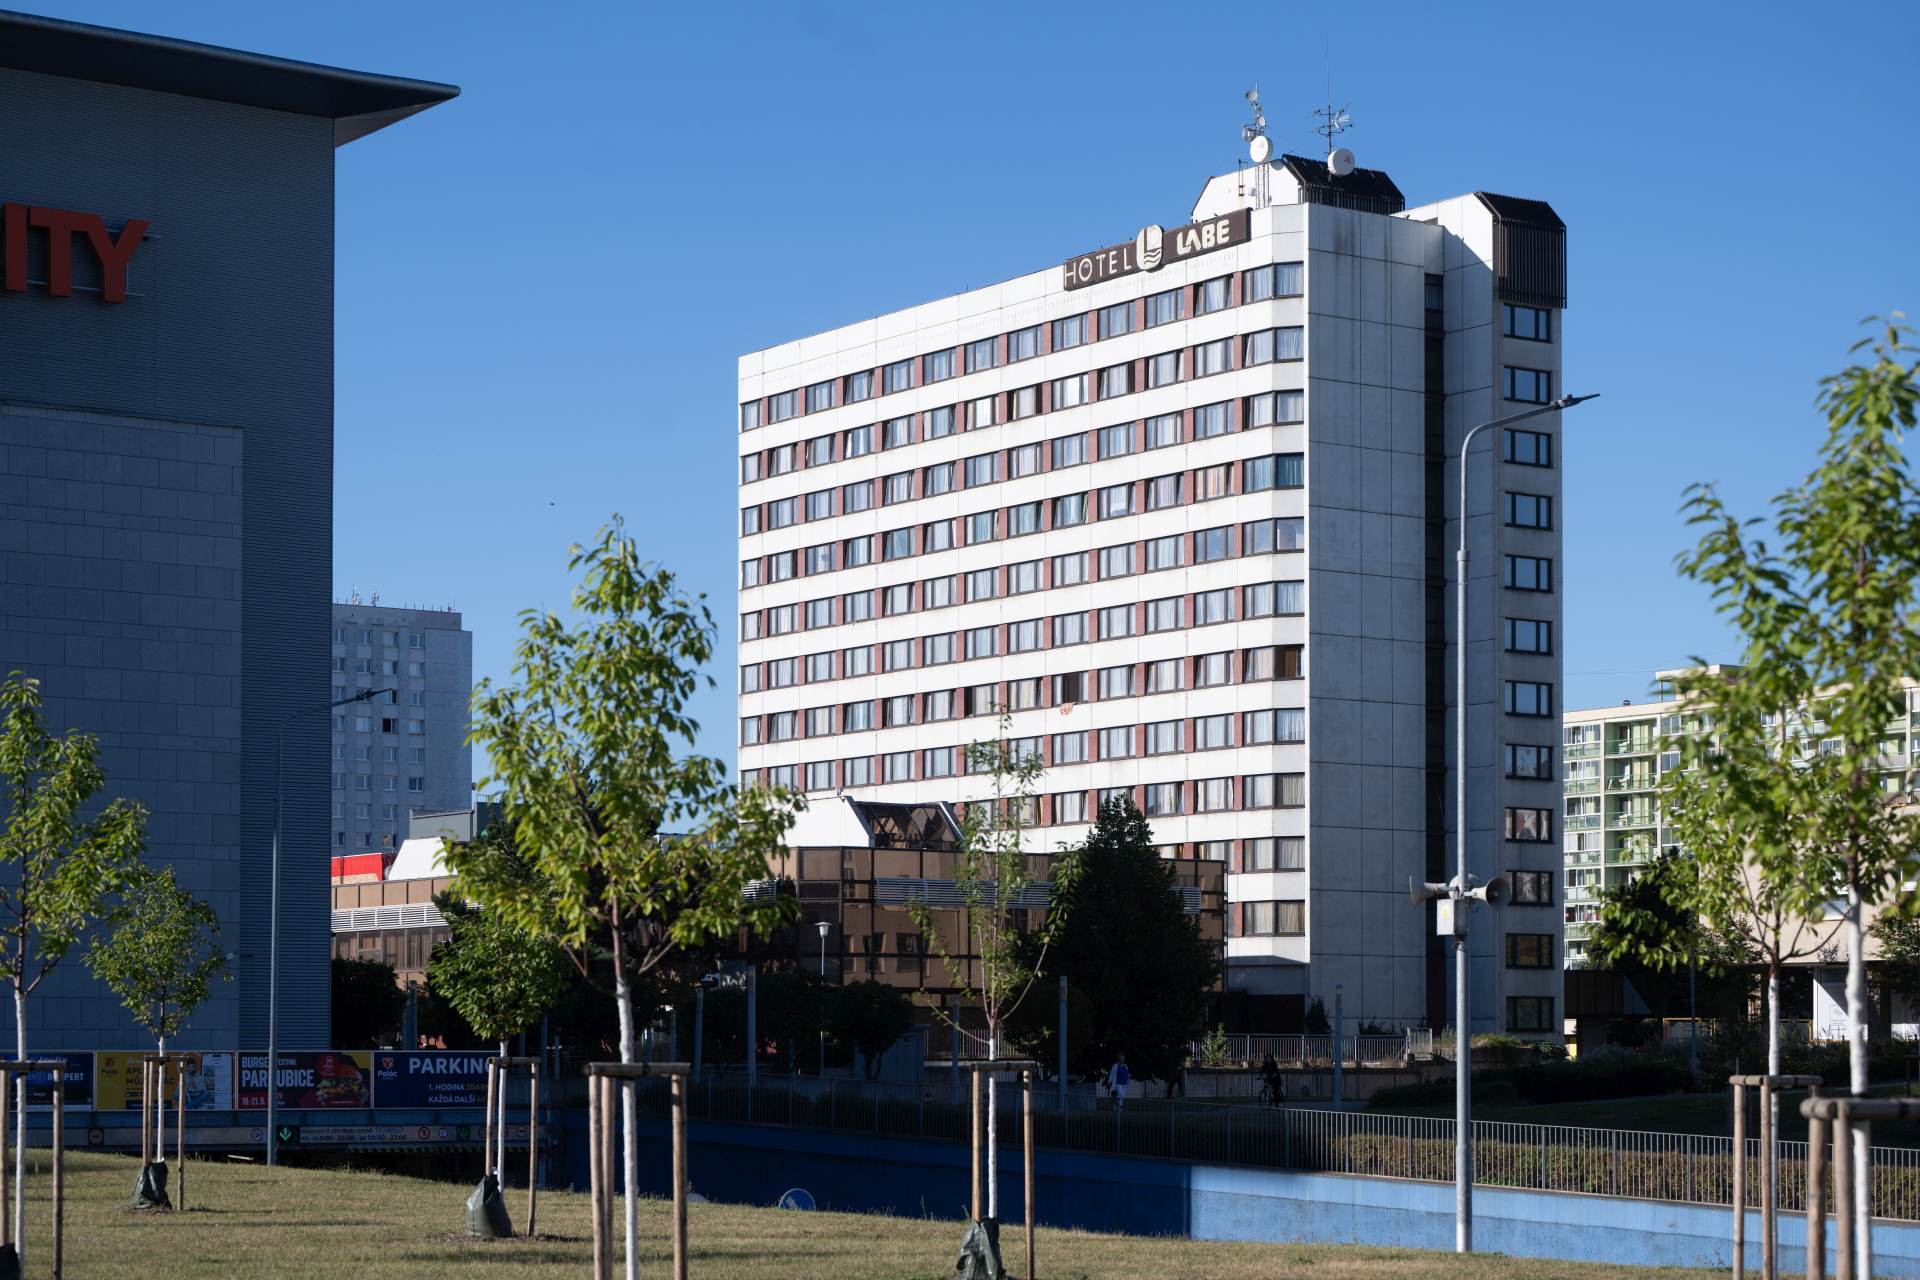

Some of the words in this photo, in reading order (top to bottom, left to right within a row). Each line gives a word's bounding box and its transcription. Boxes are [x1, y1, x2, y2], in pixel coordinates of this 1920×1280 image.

[5, 202, 150, 304] ITY
[1064, 247, 1132, 286] HOTEL
[1176, 219, 1230, 255] LABE
[242, 1056, 269, 1068] BURGE
[47, 1072, 85, 1081] RPERT
[242, 1069, 315, 1088] PARUBICE
[435, 1083, 465, 1091] HODINA
[428, 1094, 454, 1103] KAŽDÁ
[454, 1094, 476, 1103] DALŠÍ
